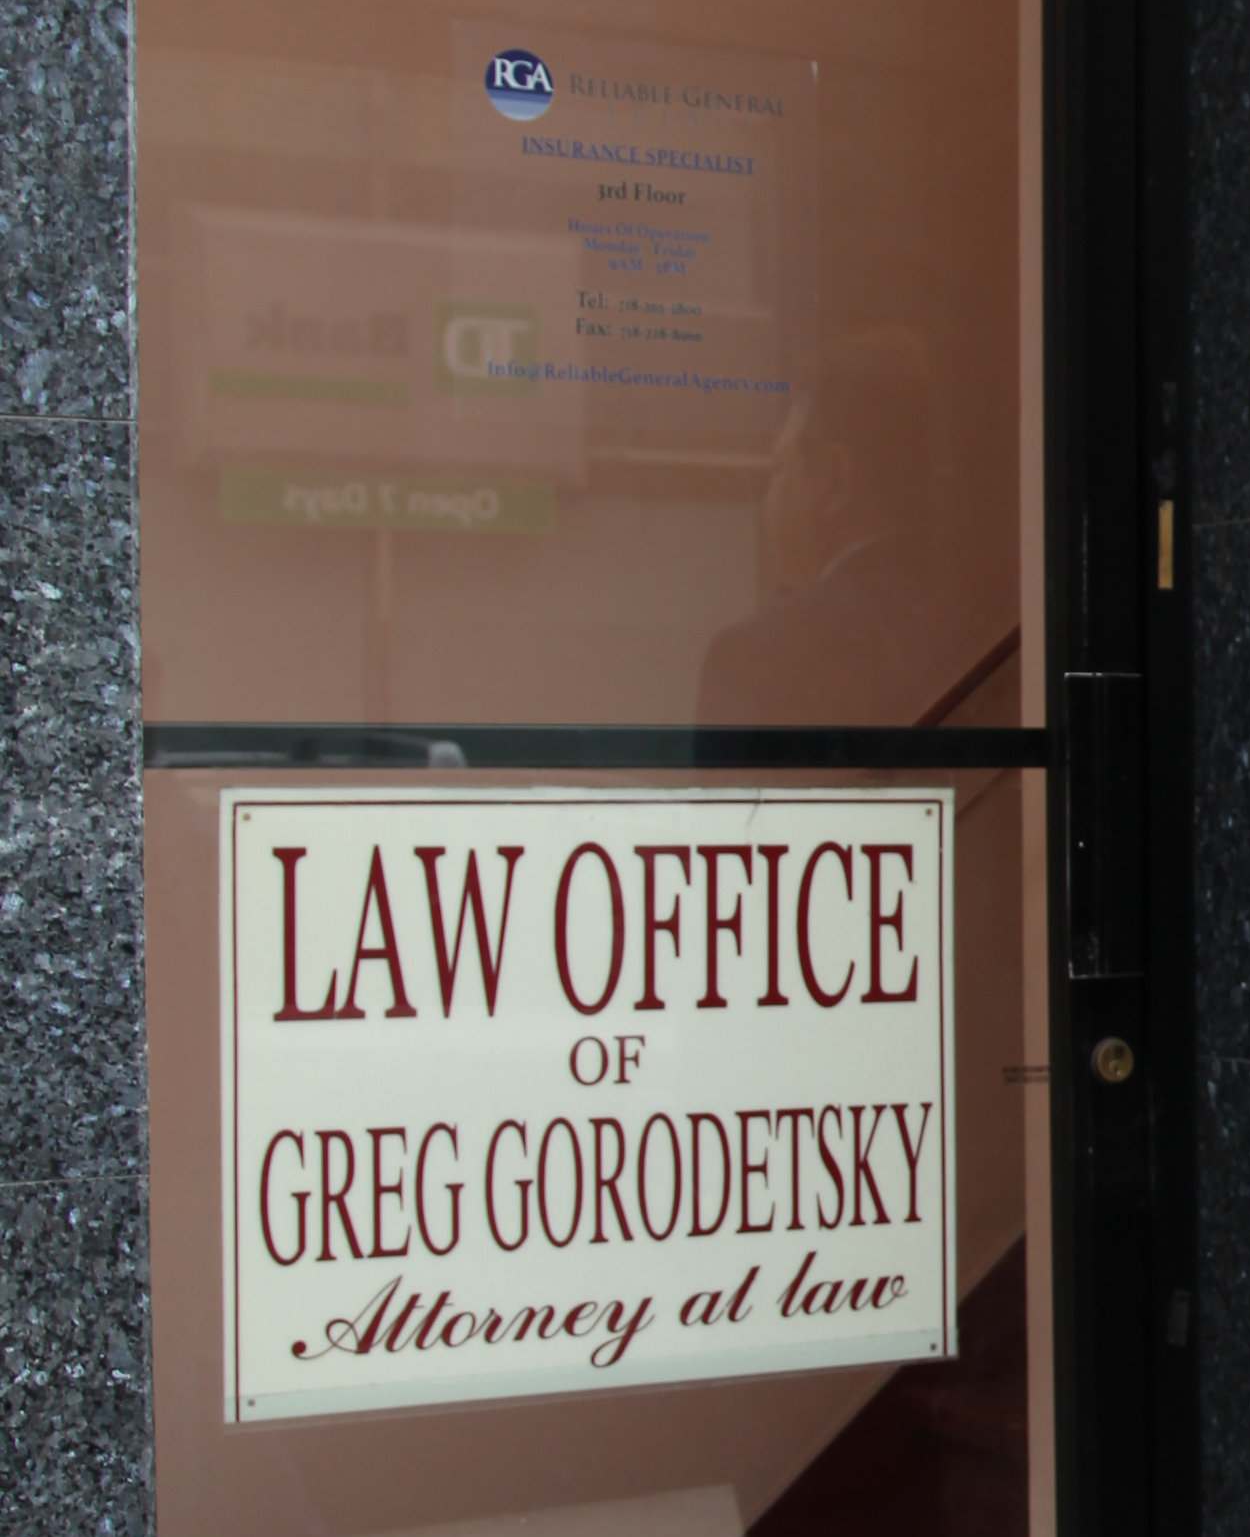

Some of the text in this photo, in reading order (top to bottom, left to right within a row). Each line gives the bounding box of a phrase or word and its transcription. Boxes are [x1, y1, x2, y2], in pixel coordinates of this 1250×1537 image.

[492, 57, 554, 92] RGA
[570, 74, 786, 117] RELIABLE GENERAL
[522, 136, 757, 175] INSURANCE SPECIALIST
[597, 181, 686, 205] 3rd Floor
[583, 237, 640, 254] Monday
[653, 243, 698, 260] Friday
[576, 290, 608, 310] Tel:
[576, 318, 611, 337] Fax:
[272, 841, 919, 1022] LAW OFFICE
[568, 1035, 646, 1086] OF
[259, 1102, 933, 1266] GREG GORODETSKY
[291, 1251, 908, 1369] Attorney at law
